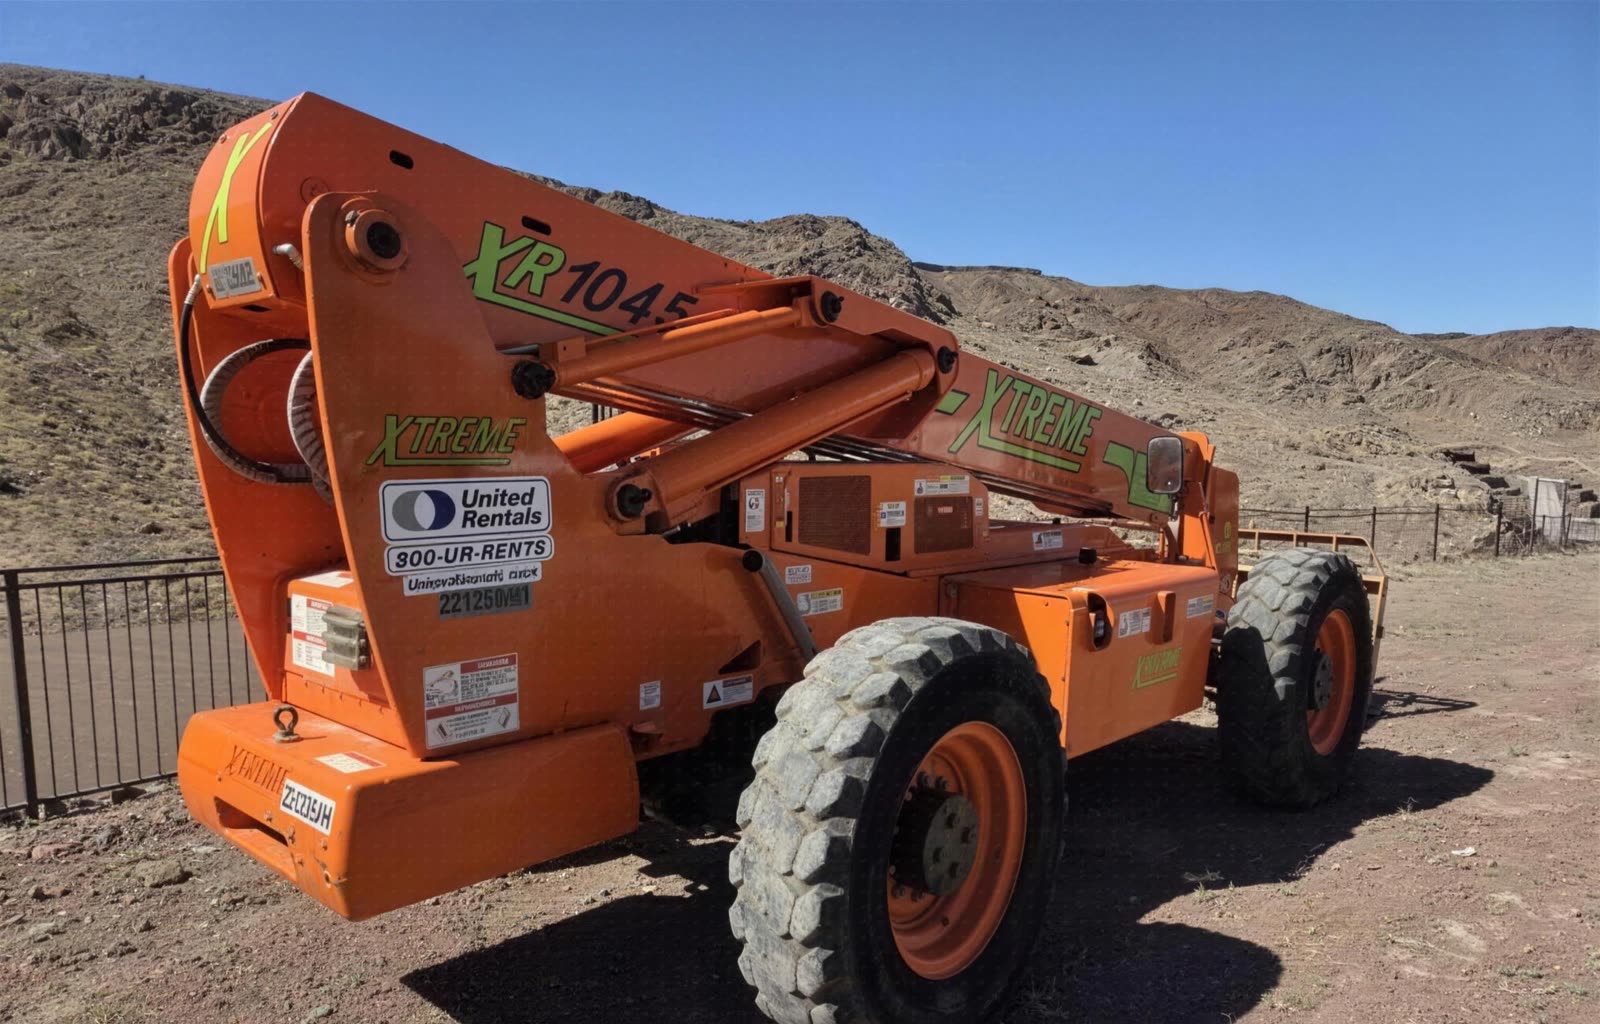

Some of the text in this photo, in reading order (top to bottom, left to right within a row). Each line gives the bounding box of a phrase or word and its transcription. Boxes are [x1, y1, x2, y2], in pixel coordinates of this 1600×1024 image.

[948, 367, 1103, 474] XTREME
[366, 414, 527, 467] XTREME
[461, 487, 536, 508] United
[461, 507, 542, 529] Rentals
